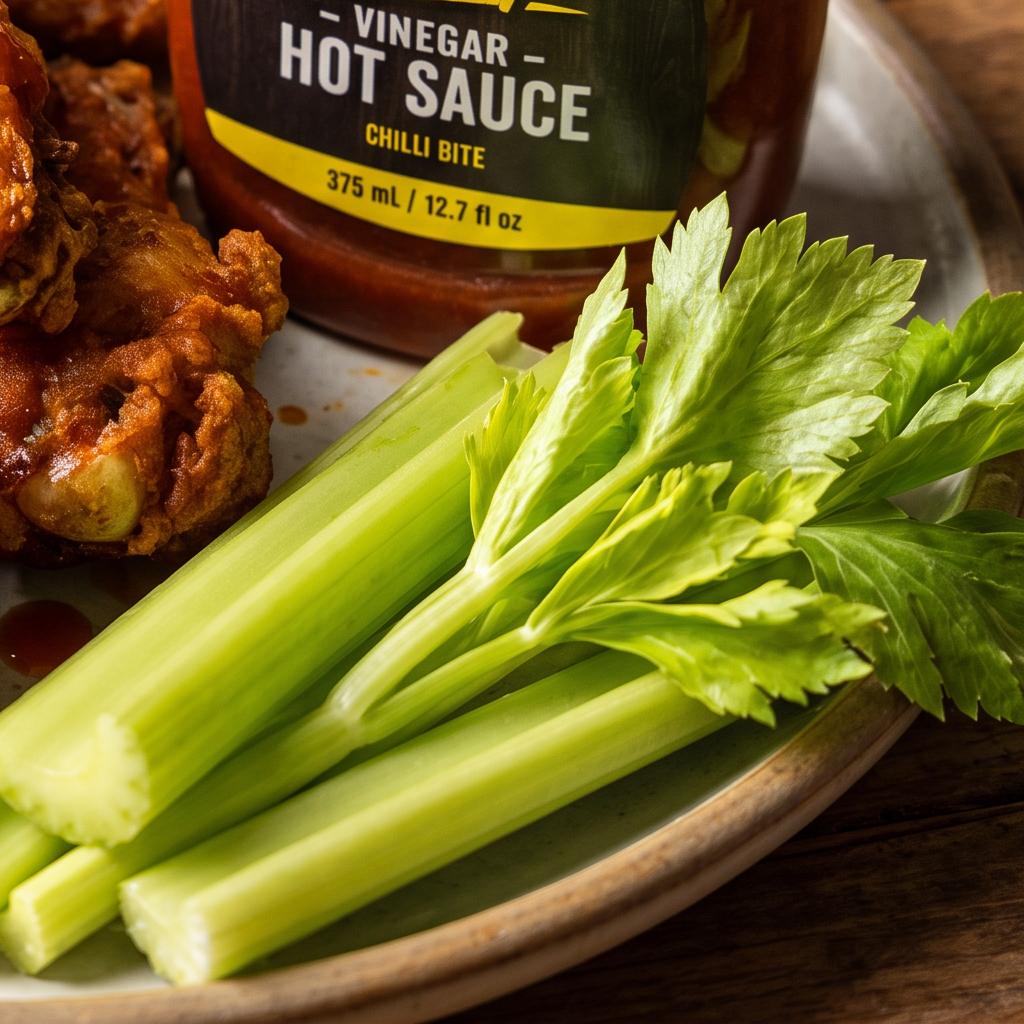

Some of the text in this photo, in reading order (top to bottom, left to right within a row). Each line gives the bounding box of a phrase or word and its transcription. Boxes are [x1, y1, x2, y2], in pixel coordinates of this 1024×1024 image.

[353, 4, 509, 67] VINEGAR
[280, 21, 592, 142] HOT SAUCE
[365, 123, 486, 169] CHILLI BITE
[326, 169, 364, 199] 375
[425, 194, 468, 224] 12.7
[474, 204, 492, 227] fl
[498, 213, 523, 232] oz
